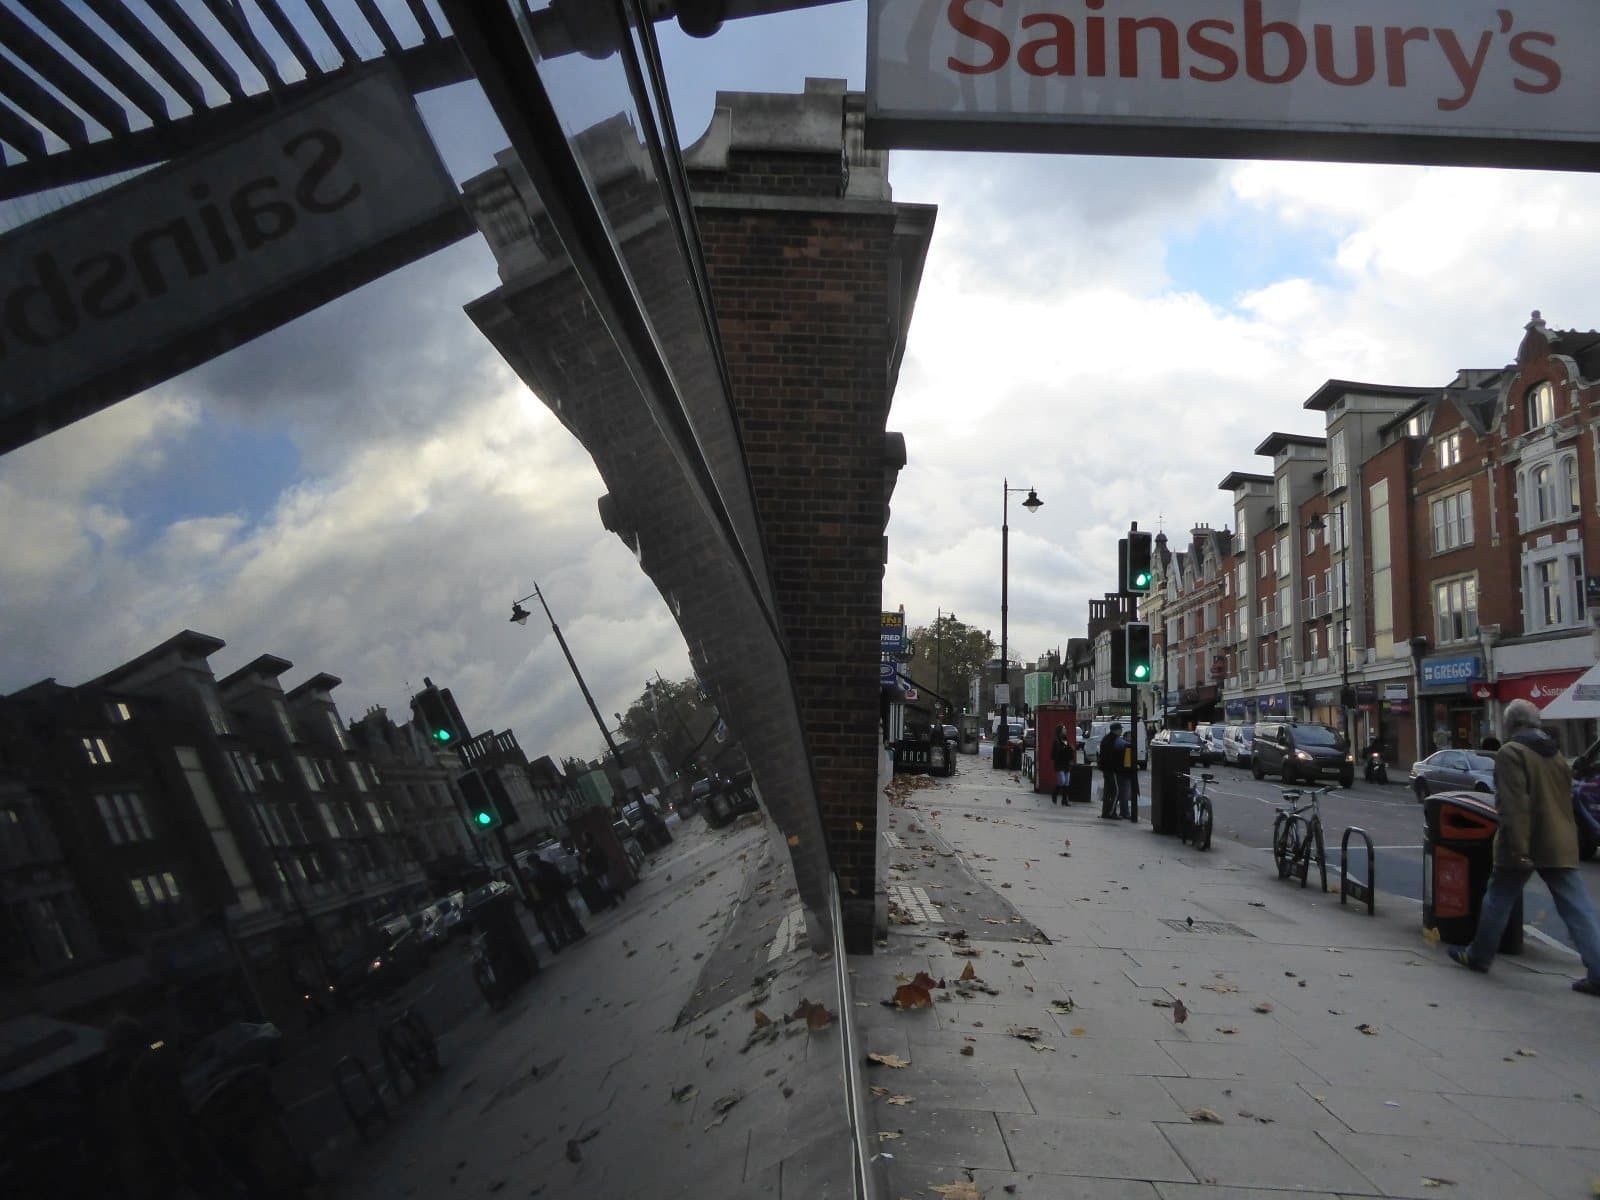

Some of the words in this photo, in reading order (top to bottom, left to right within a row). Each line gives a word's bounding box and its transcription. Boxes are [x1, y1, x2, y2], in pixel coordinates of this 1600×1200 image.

[947, 0, 1562, 110] Sainsbury's
[1433, 662, 1473, 680] GREGGS
[1541, 685, 1569, 697] Santa
